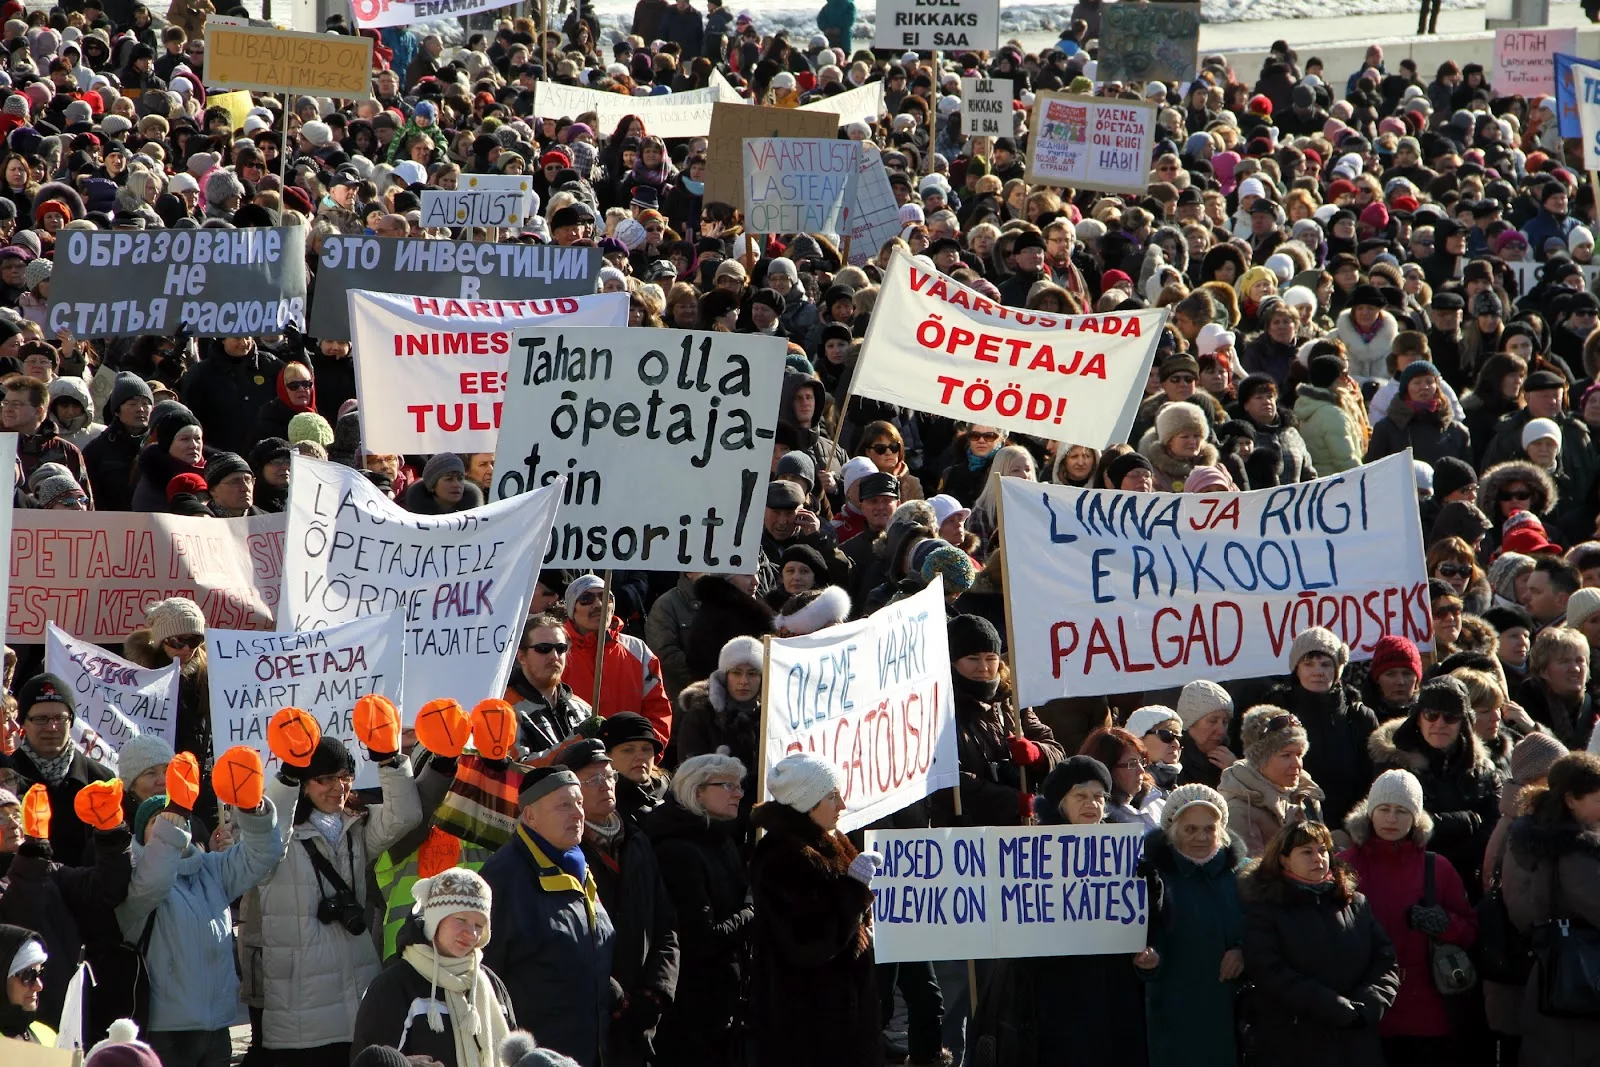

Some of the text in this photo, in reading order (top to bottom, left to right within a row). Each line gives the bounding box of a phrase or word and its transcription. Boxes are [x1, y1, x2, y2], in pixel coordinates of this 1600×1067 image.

[895, 13, 978, 27] RIKKAKS
[215, 33, 366, 71] LUBADUSED ON
[903, 32, 969, 46] EI SAA
[975, 80, 994, 93] LOLL
[968, 99, 1003, 114] RIKKAKS
[1096, 107, 1137, 122] VAENE
[971, 119, 999, 133] EI SAA
[1093, 133, 1141, 150] ON RIIGI
[748, 140, 858, 174] VÄÄRTUSTA
[427, 193, 524, 225] AUSTUST
[321, 237, 381, 270] ЭТО
[412, 297, 580, 318] HARITUD
[394, 332, 513, 356] INIMES
[915, 312, 1108, 380] ÕPETAJA
[518, 334, 751, 397] Tahan olla
[936, 375, 1068, 425] TÖÖD!
[550, 389, 775, 468] õpetaja-
[1042, 473, 1368, 544] LINNA JA RIIGI
[11, 529, 156, 579] PETAJA
[304, 520, 505, 578] ÕPETAJATELE
[1092, 538, 1339, 603] ERIKOOLI
[6, 586, 89, 636] ESTI
[432, 578, 495, 621] PALK
[216, 631, 328, 659] LASTEAIA
[1050, 580, 1434, 680] PALGAD VÕRDSEKS
[255, 645, 368, 682] ÕPETAJA
[786, 608, 929, 730] OLEME VÄÄRT
[224, 674, 384, 709] VÄÄRT AMET
[873, 834, 1146, 879] LAPSED ON MEIE TULEVIK
[953, 885, 986, 924] ON
[1001, 882, 1055, 924] MEIE
[1062, 879, 1147, 925] KÄTES!
